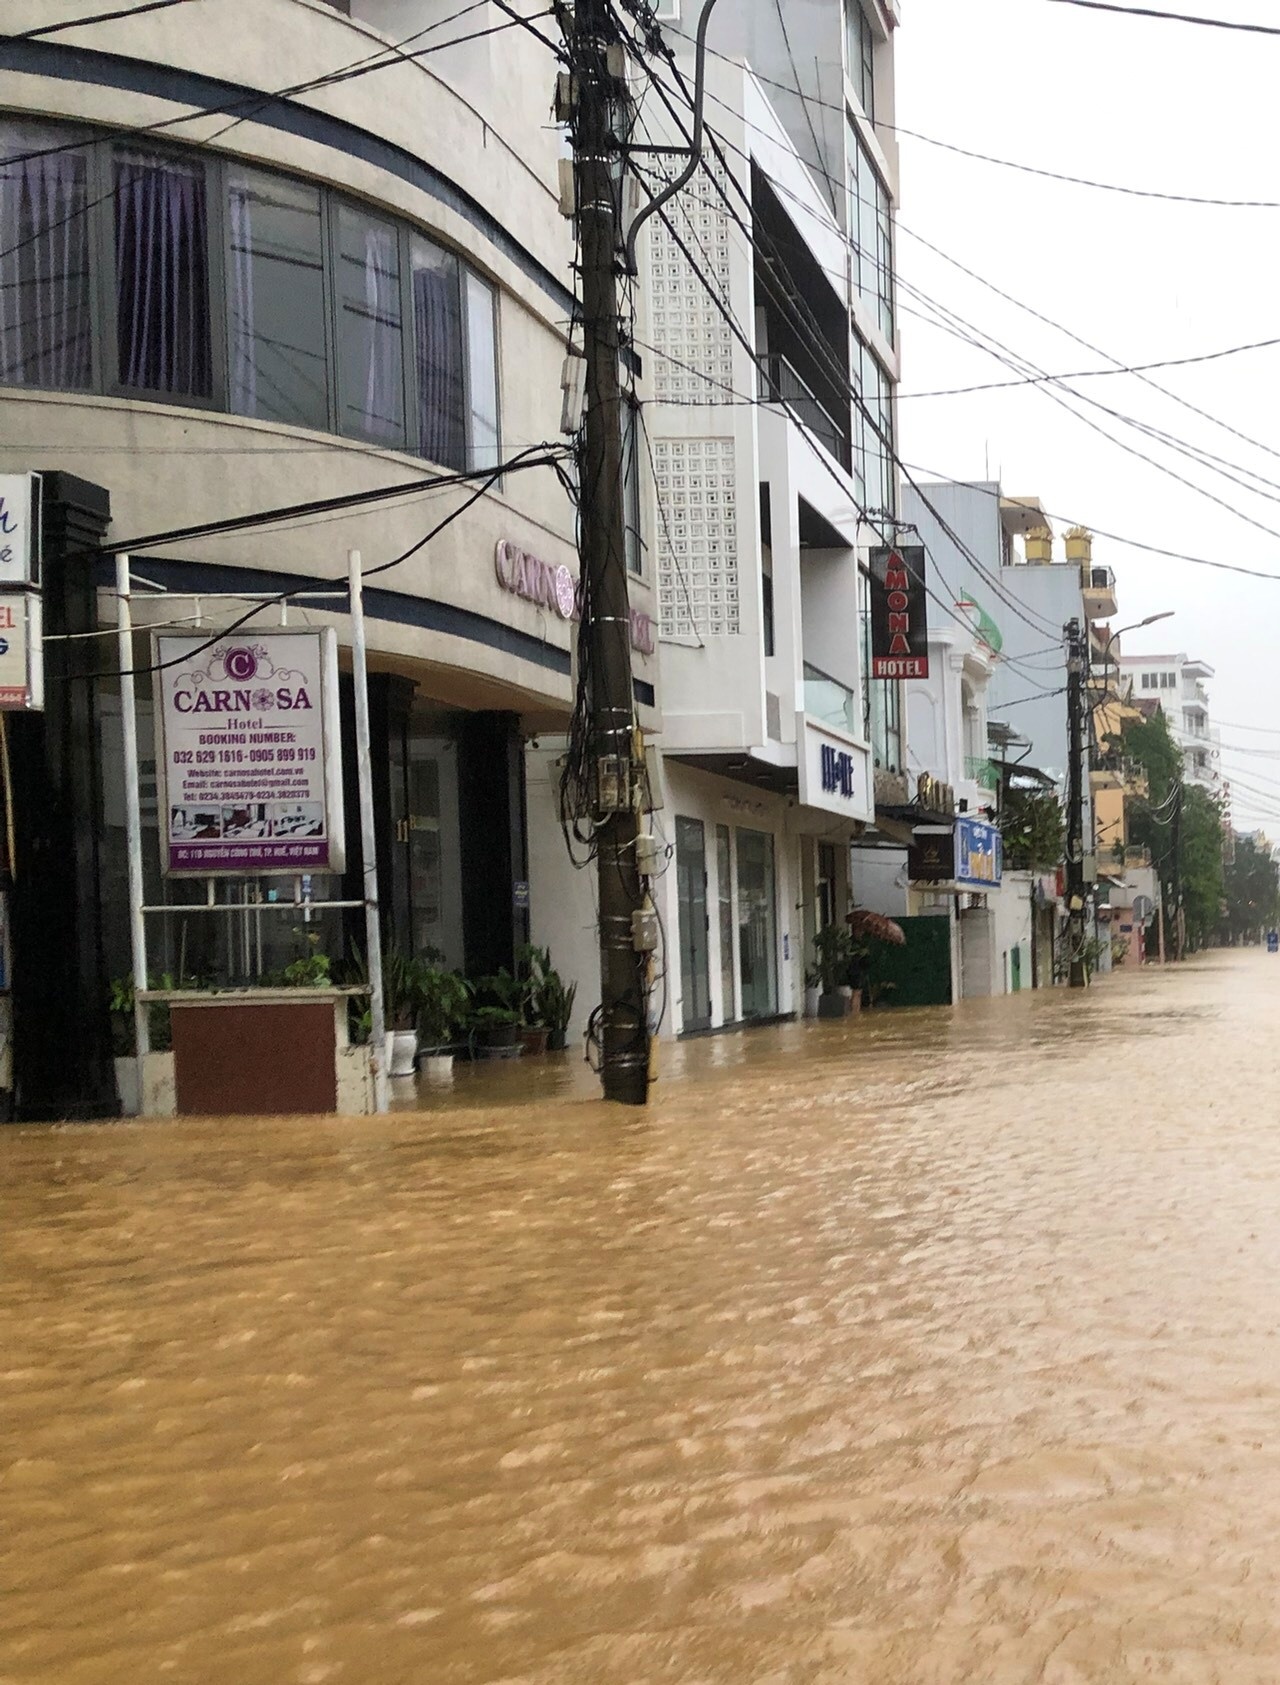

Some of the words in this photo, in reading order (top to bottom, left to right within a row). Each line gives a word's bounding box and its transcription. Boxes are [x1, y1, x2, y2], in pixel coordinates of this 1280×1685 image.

[877, 660, 923, 676] HOTEL
[227, 718, 264, 731] Hotel
[199, 734, 246, 745] BOOKING
[250, 732, 296, 743] NUMBER:
